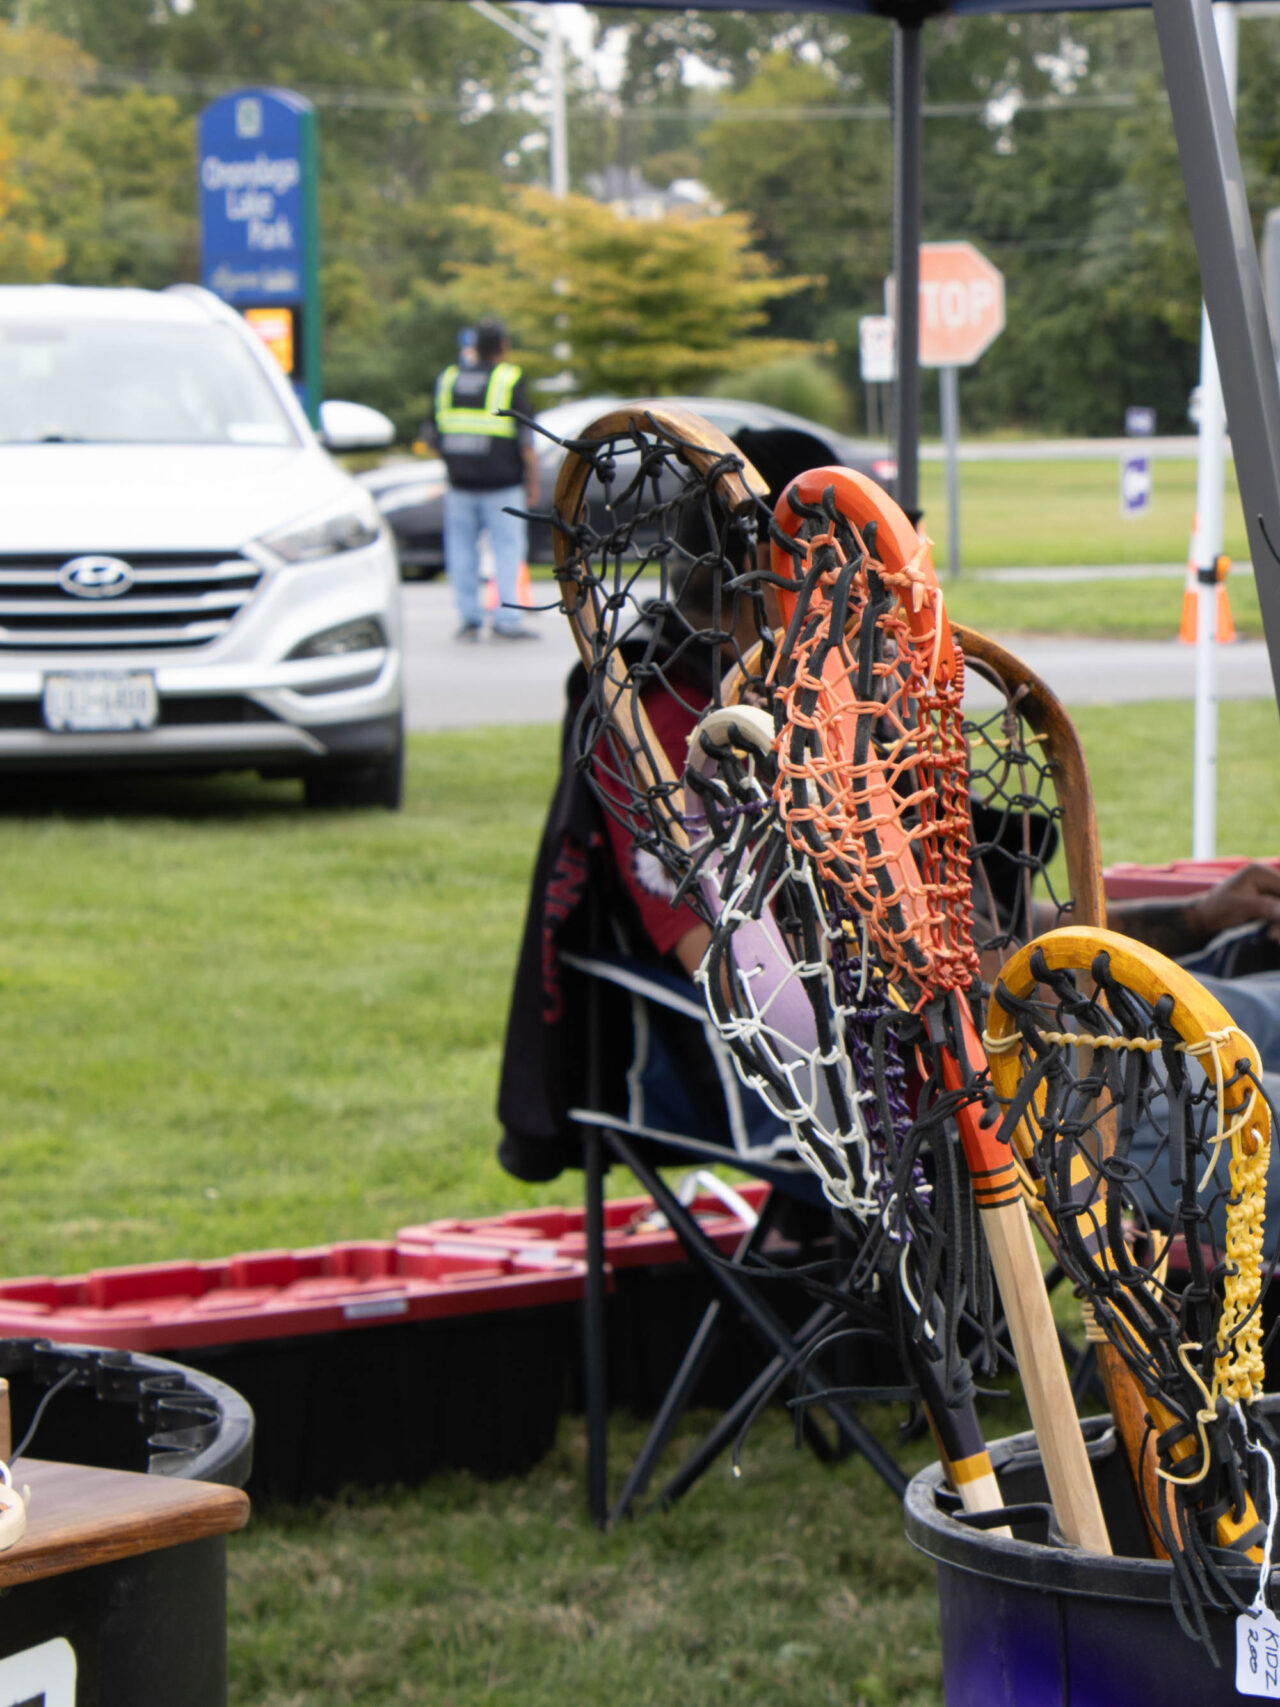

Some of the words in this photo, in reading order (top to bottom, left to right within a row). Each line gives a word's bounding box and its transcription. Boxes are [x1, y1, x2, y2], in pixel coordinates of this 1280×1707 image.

[919, 279, 993, 329] TOP
[1247, 1628, 1259, 1675] 200
[1262, 1627, 1280, 1691] KIDZ
